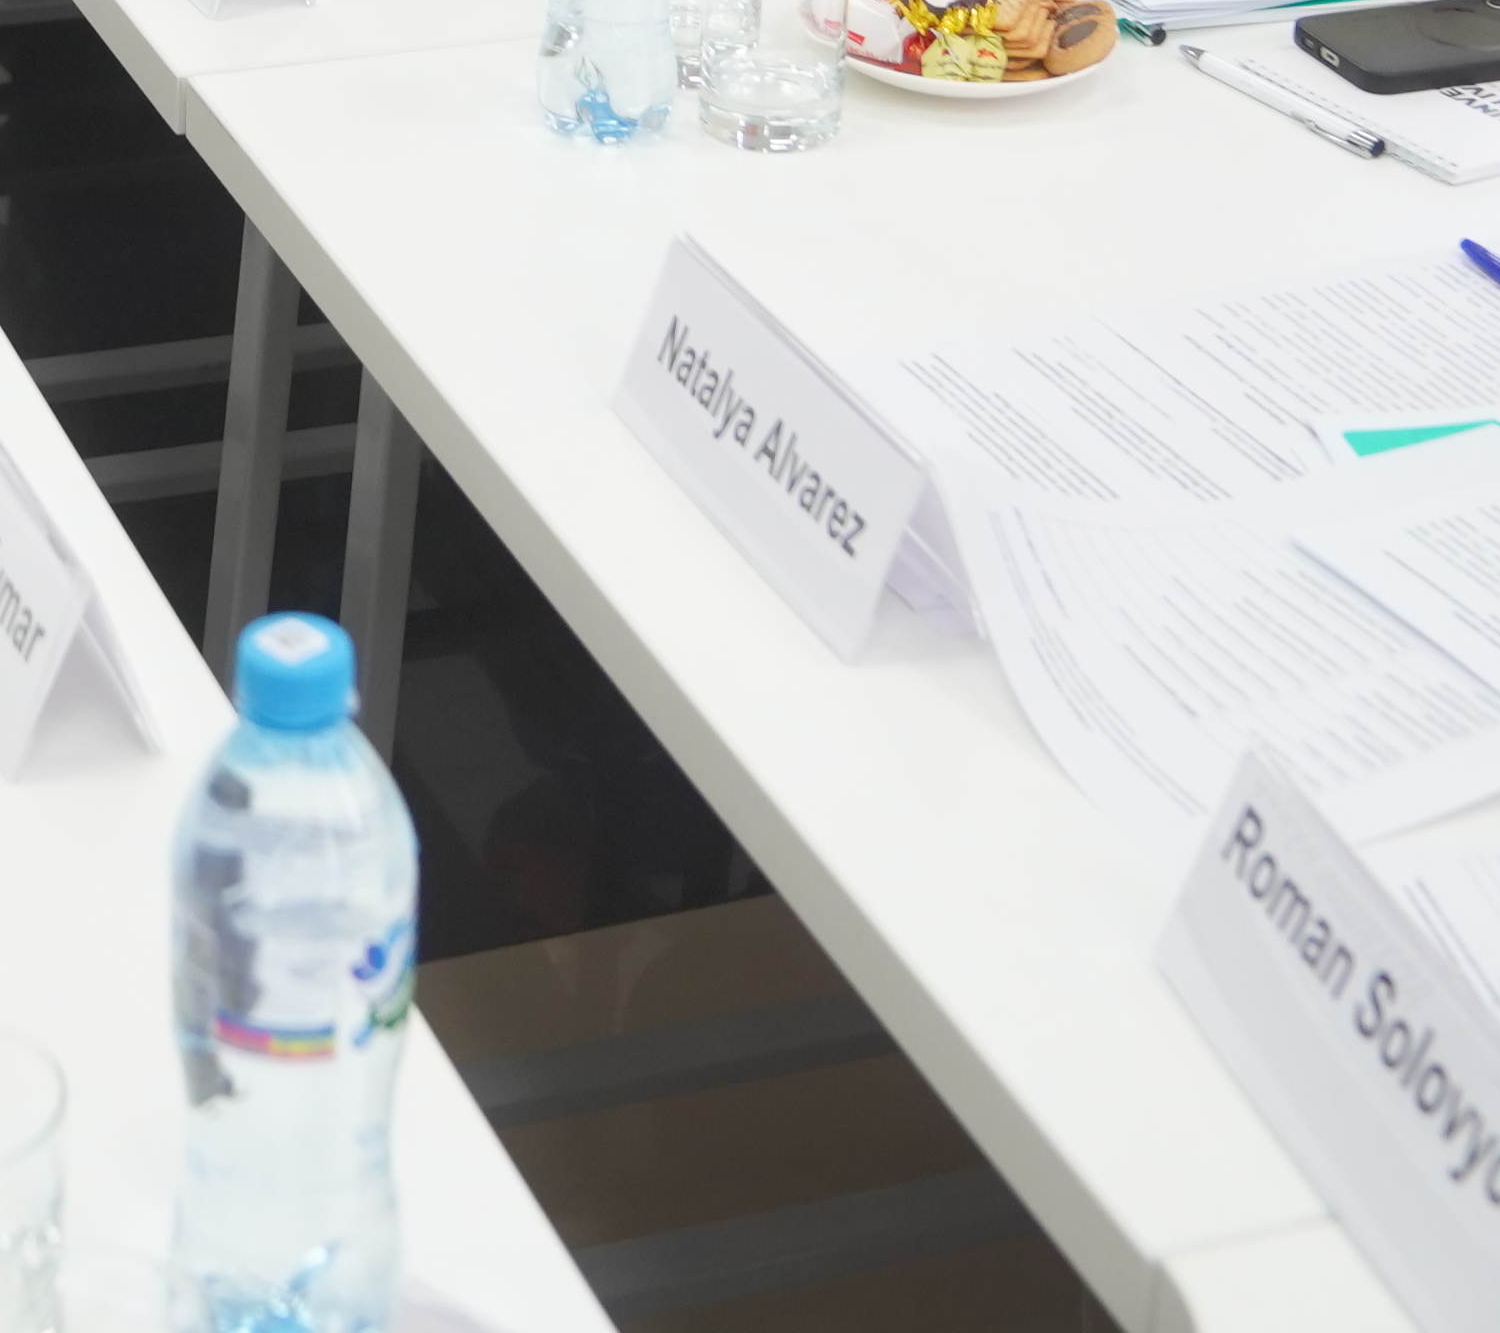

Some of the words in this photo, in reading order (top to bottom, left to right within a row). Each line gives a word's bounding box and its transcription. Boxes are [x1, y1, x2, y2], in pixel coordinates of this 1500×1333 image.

[656, 314, 756, 449] Natalya
[753, 417, 866, 559] Alvarez
[1220, 804, 1357, 1000] Roman
